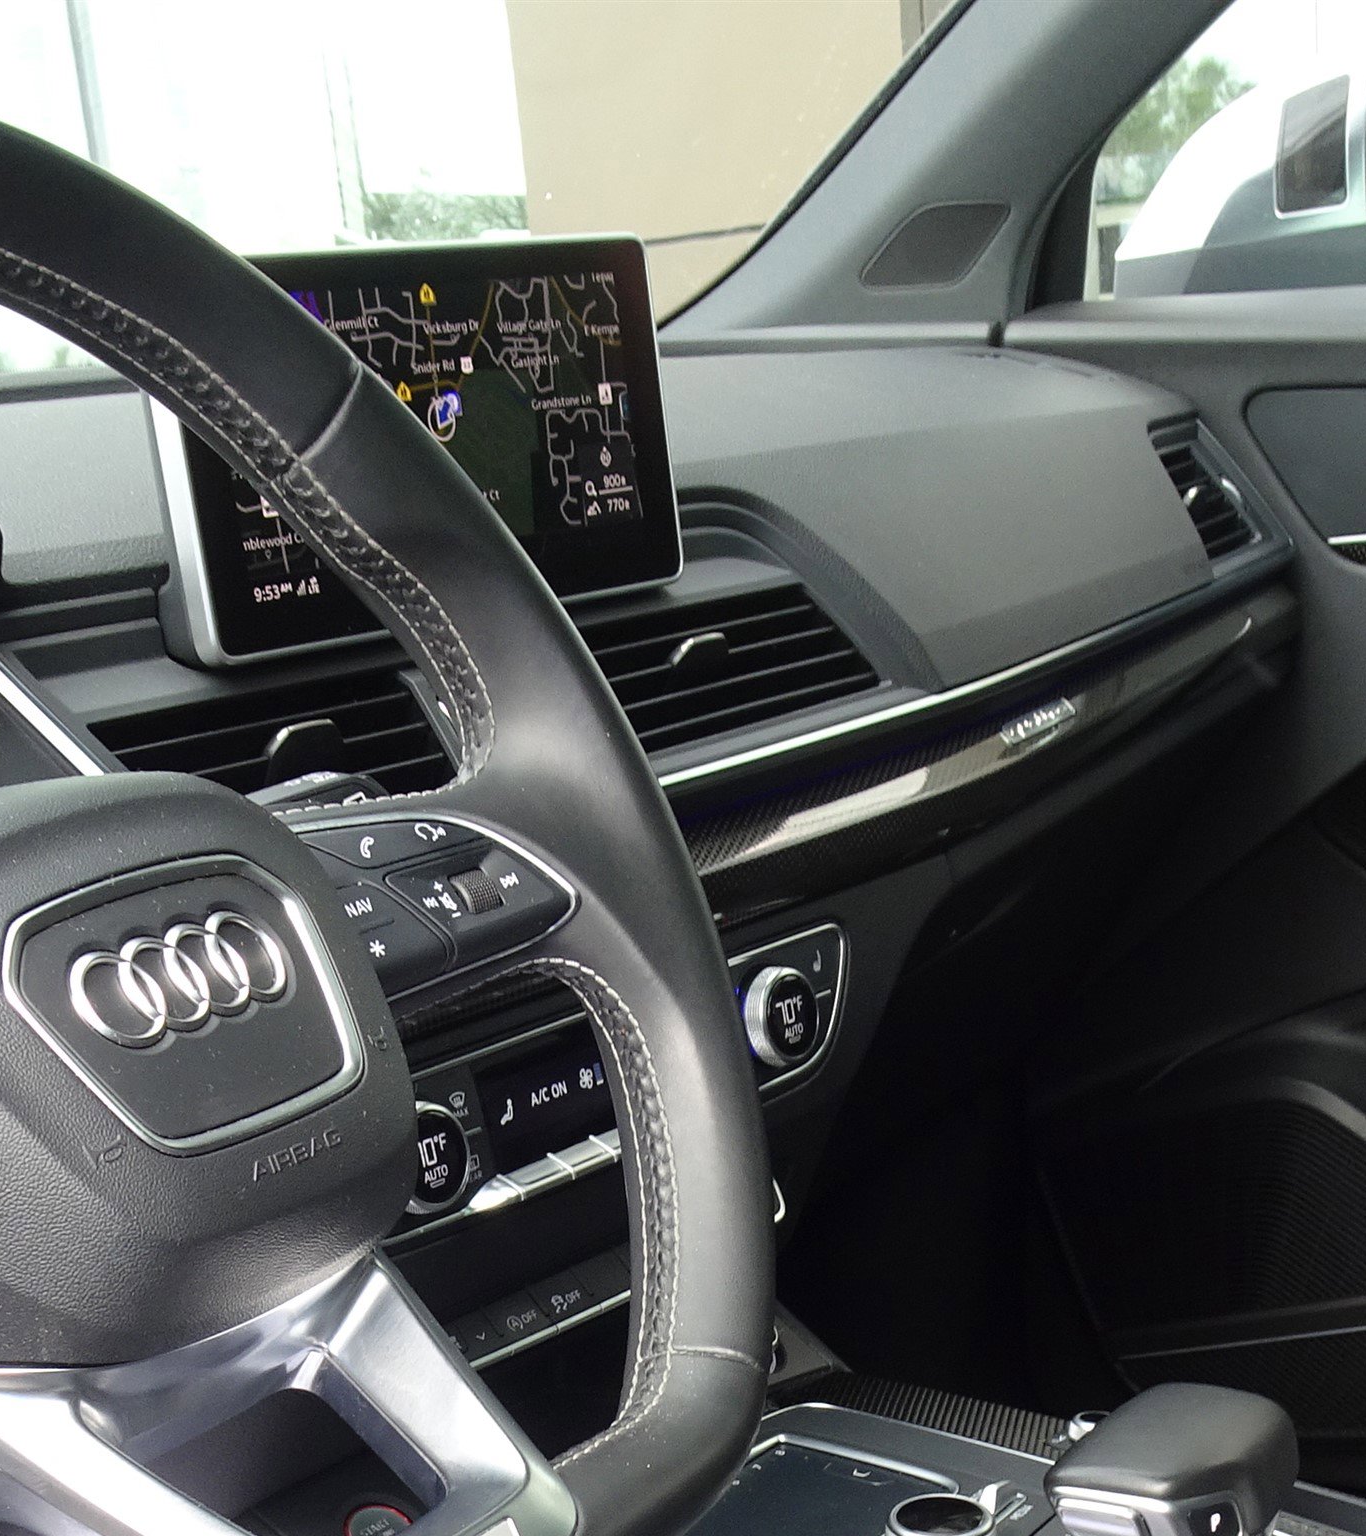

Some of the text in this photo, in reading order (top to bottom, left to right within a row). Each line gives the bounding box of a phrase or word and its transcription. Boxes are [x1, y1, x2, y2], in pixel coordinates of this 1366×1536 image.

[368, 315, 380, 329] Ct
[422, 319, 480, 335] Vicksburg Dr
[497, 318, 562, 336] Village Gate Ln
[412, 361, 441, 376] Snider
[442, 359, 456, 372] Rd
[549, 353, 560, 366] Ln
[531, 393, 592, 411] Grandstone Ln
[344, 898, 373, 919] NAV
[784, 1022, 804, 1040] AUTO
[531, 1081, 568, 1108] A/C ON
[252, 1130, 343, 1182] AIRBAG
[424, 1164, 449, 1185] AUTO
[565, 1289, 582, 1305] OFF
[521, 1309, 538, 1324] OFF
[1210, 1512, 1222, 1534] P
